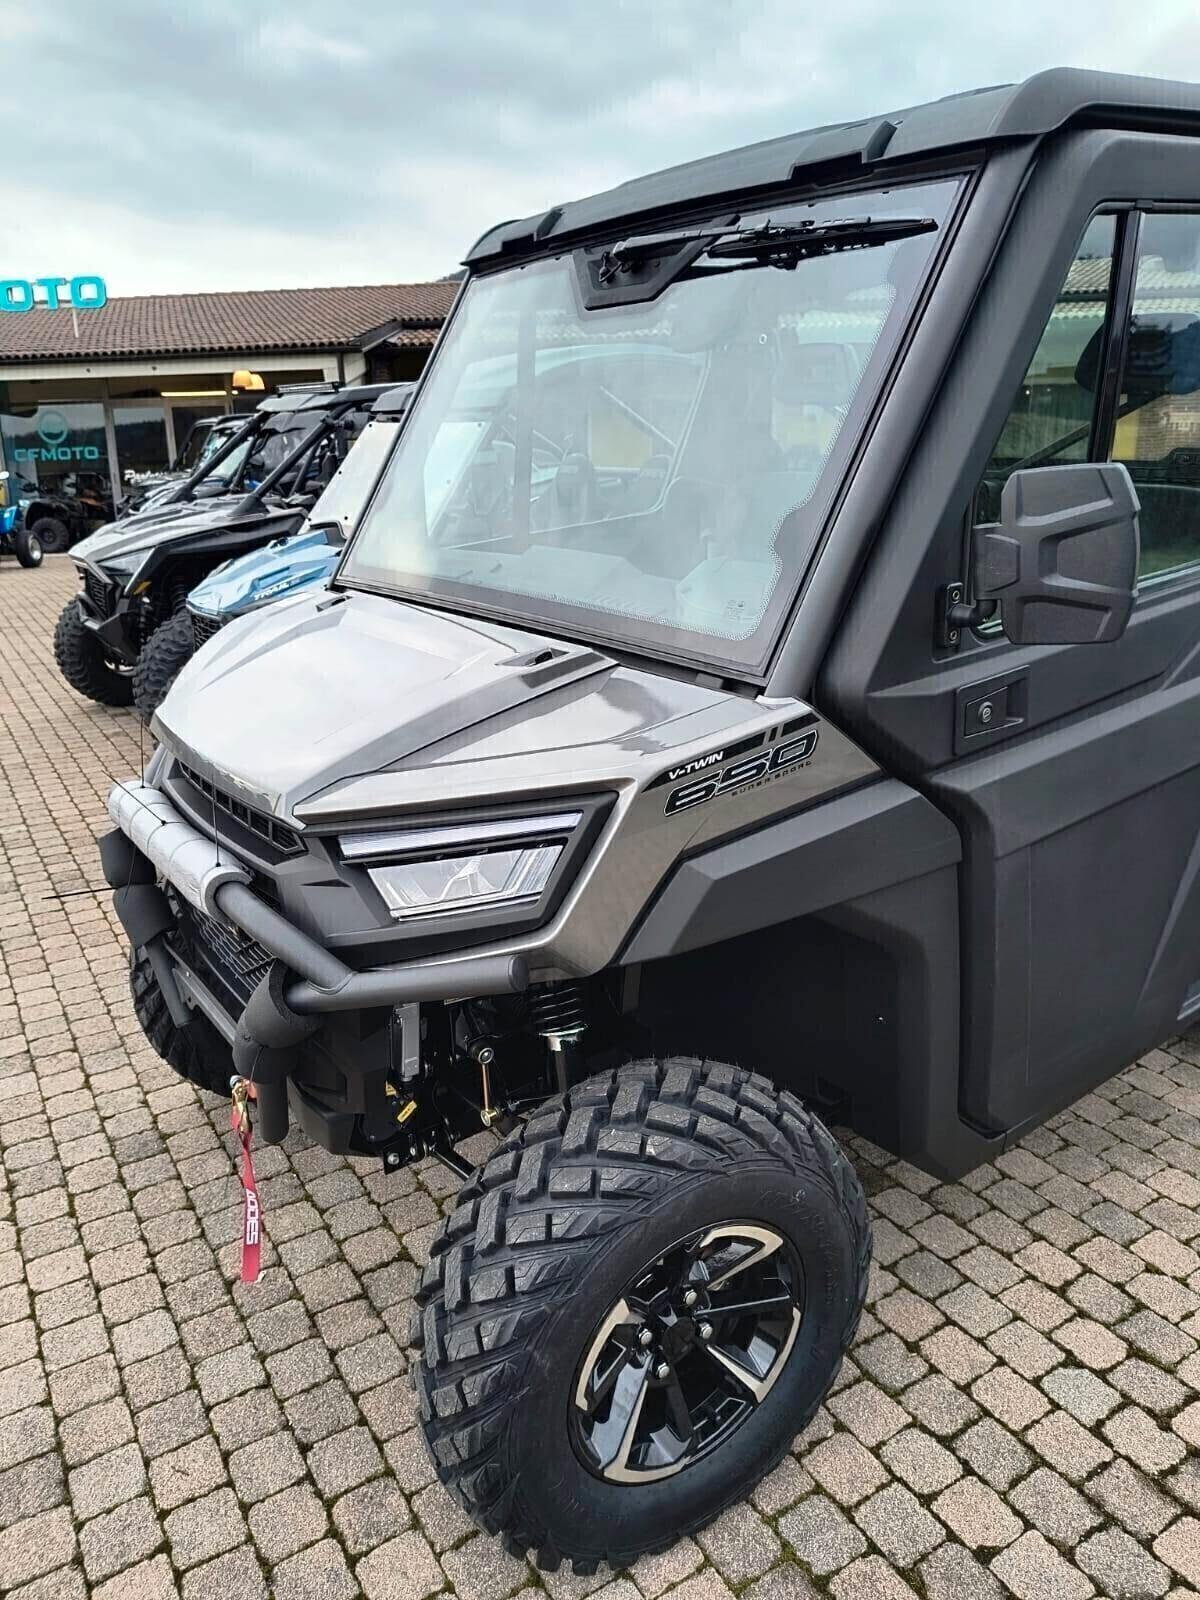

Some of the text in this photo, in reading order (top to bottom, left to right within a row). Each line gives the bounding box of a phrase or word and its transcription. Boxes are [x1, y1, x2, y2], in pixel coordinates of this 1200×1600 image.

[14, 446, 99, 462] CFMOTO
[663, 729, 819, 818] 650
[667, 750, 724, 781] V-TWIN
[245, 1187, 259, 1246] AODES
